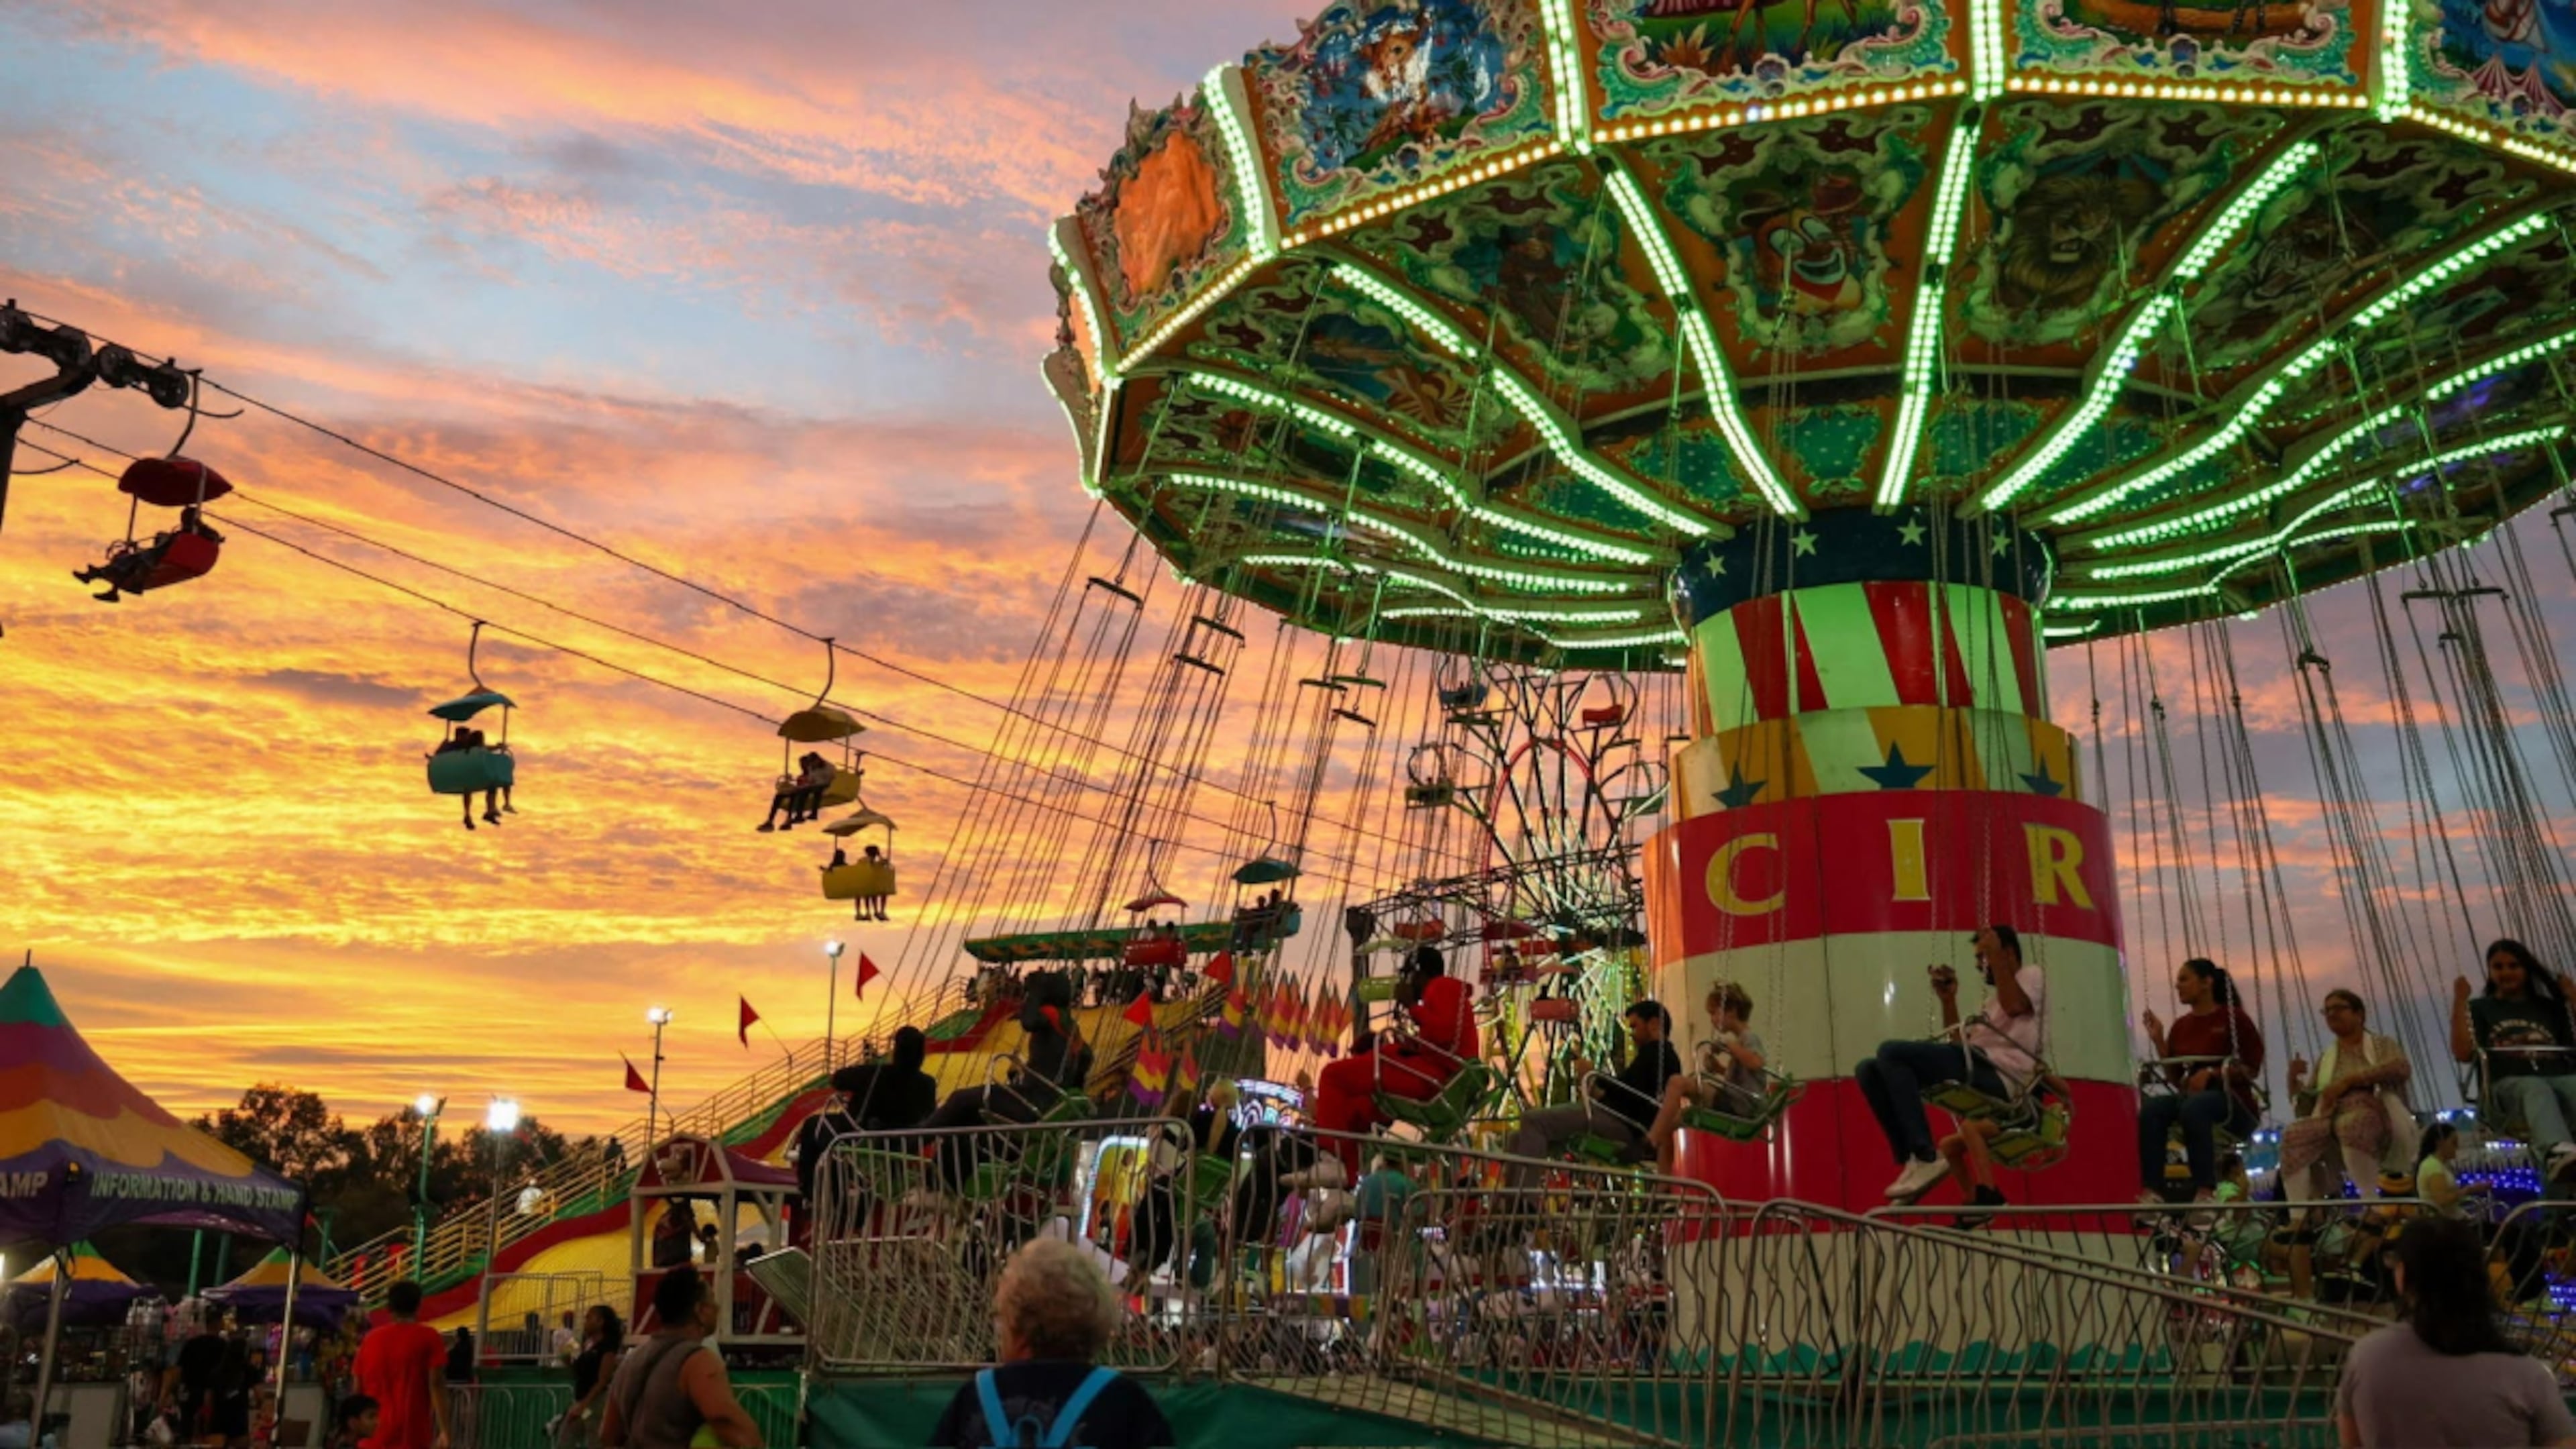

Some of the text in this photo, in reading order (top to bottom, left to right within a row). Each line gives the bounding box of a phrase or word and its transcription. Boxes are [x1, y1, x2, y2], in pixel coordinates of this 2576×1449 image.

[1705, 818, 2095, 916] CIR
[90, 1172, 299, 1212] INFORMATION & HAND STAMP
